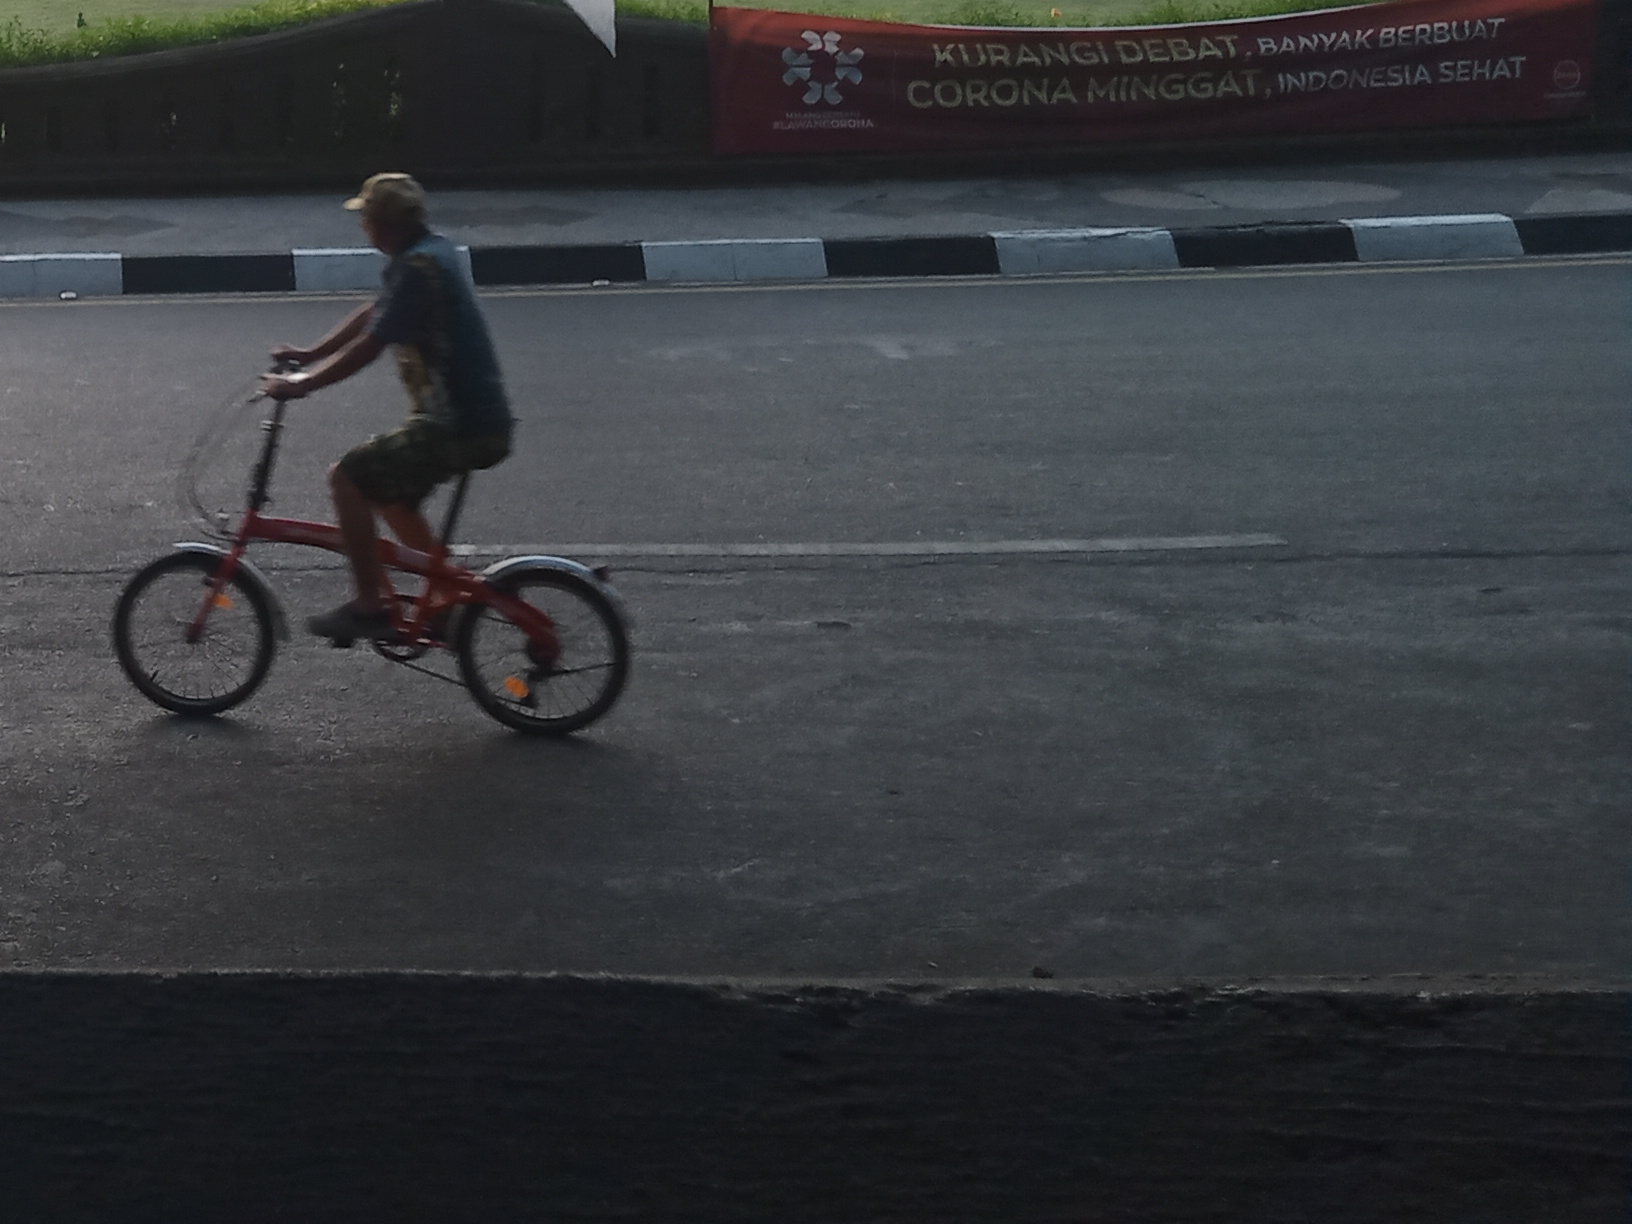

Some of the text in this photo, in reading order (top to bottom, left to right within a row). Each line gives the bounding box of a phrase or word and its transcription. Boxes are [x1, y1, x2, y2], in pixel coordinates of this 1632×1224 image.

[932, 42, 1109, 68] KURANGI
[1257, 29, 1374, 57] BANYAK
[1378, 17, 1505, 49] BERBUAT
[907, 78, 1077, 109] CORONA
[1277, 62, 1432, 93] INDONESIA
[1438, 56, 1527, 83] SEHAT
